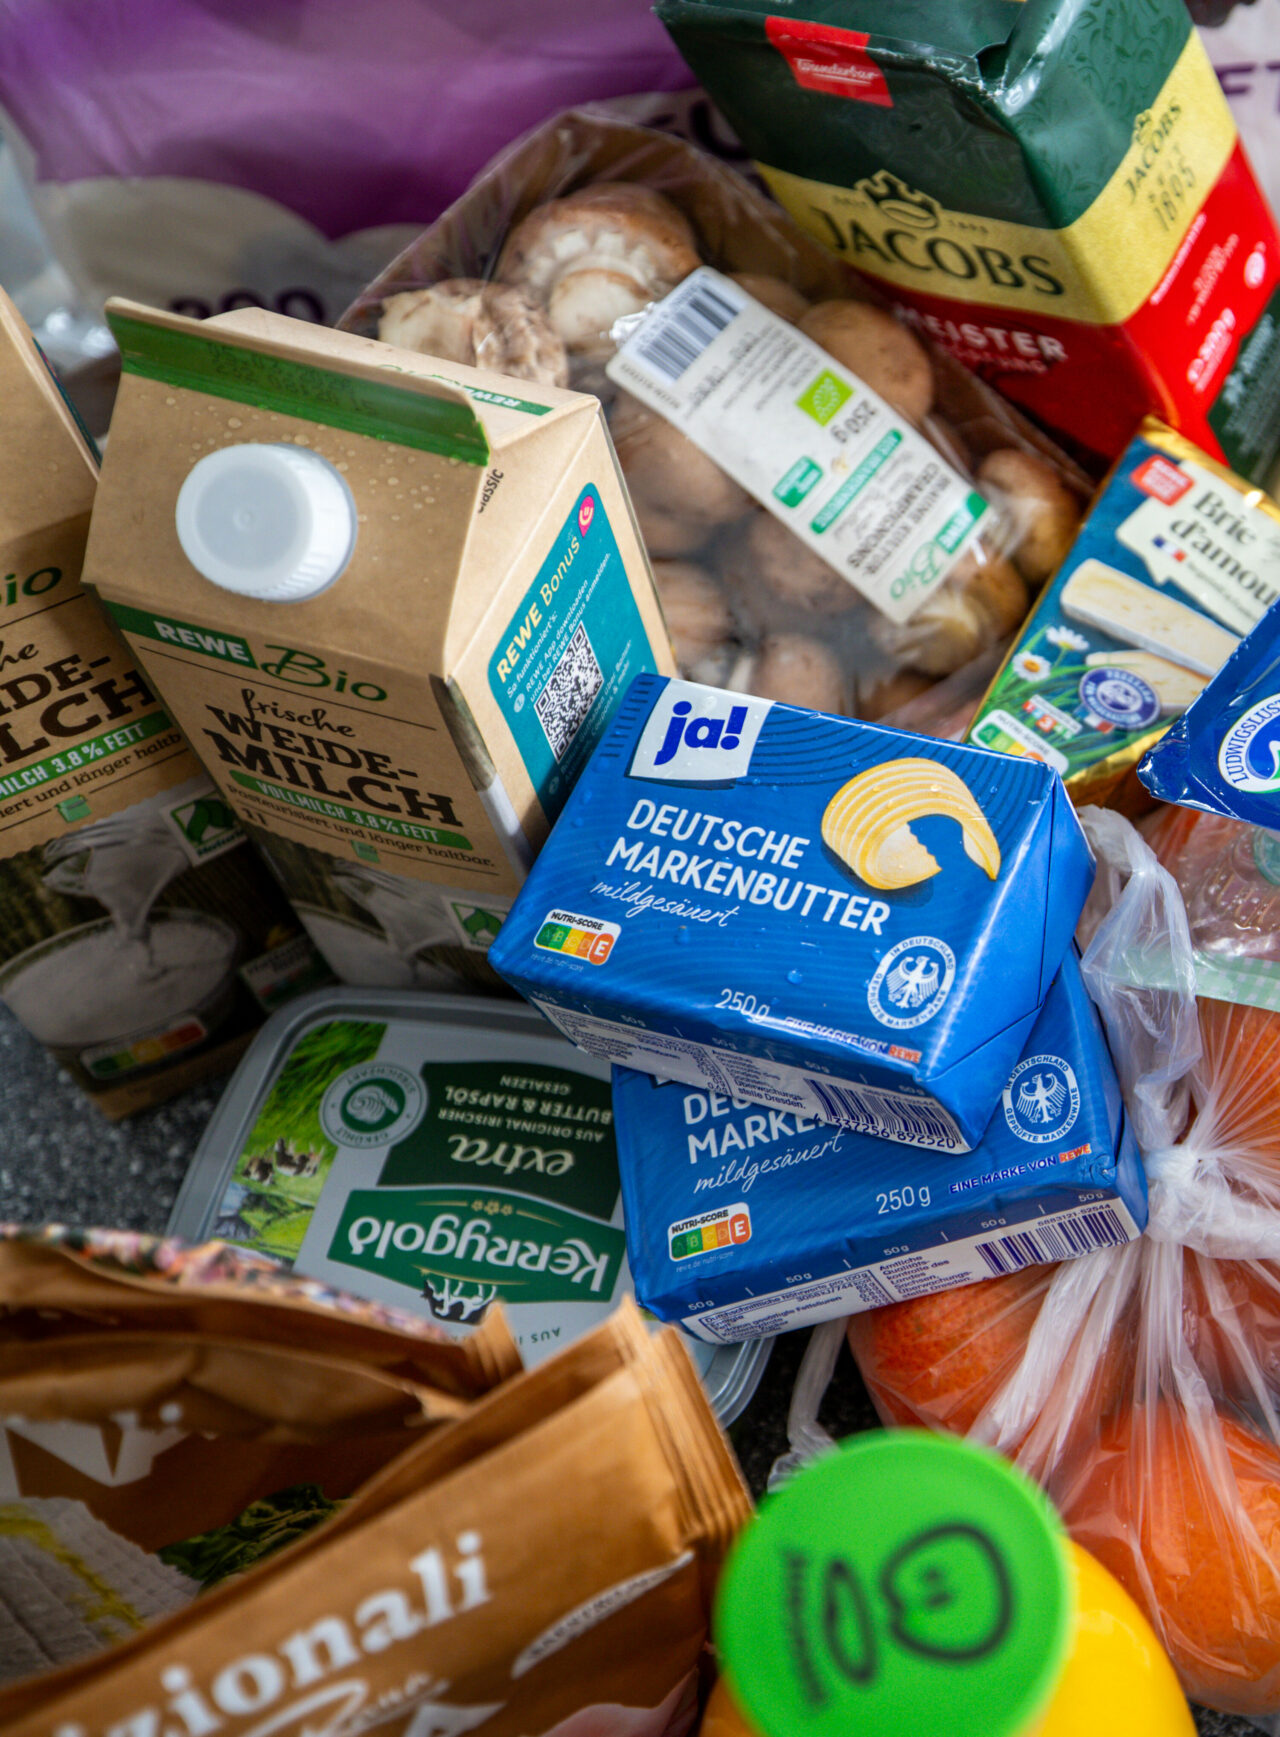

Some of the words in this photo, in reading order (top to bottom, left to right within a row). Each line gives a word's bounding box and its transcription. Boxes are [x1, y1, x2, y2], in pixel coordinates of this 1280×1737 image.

[811, 206, 1064, 296] JACOBS
[1193, 489, 1257, 546] Brie
[2, 566, 63, 607] io
[889, 540, 949, 601] Bio
[1170, 517, 1280, 606] d'amou
[496, 603, 542, 684] REWE
[540, 535, 580, 608] Bonus
[152, 619, 252, 664] REWE
[259, 643, 388, 702] Bio
[525, 666, 544, 693] REWE
[543, 643, 557, 670] App
[555, 579, 589, 646] downloaden
[529, 677, 544, 703] und
[551, 638, 569, 665] REWE
[567, 604, 585, 640] Bonus
[103, 722, 145, 750] FETT
[240, 687, 356, 739] frische
[652, 694, 750, 767] ja!
[205, 704, 418, 779] WEIDE-
[34, 780, 72, 805] und
[72, 752, 133, 787] länger
[202, 727, 465, 828] MILCH
[226, 783, 332, 830] Pasteurisiert
[334, 822, 366, 842] und
[367, 828, 426, 857] länger
[427, 843, 496, 868] haltbar.
[256, 781, 348, 822] VOLLMILCH
[401, 824, 440, 844] FETT
[626, 798, 812, 872] DEUTSCHE
[588, 877, 744, 929] mildgesäuert
[605, 836, 892, 936] MARKENBUTTER
[550, 911, 605, 931] NUTRI-SCORE
[901, 936, 956, 970] DEUTSCHLAND
[714, 988, 757, 1017] 250
[885, 987, 948, 1030] MARKENWARE
[888, 1043, 923, 1065] REWE
[1010, 1055, 1070, 1082] DEUTSCHLAND
[443, 1086, 520, 1110] RAPSÖL
[499, 1074, 571, 1095] GESALZEN
[522, 1099, 536, 1114] &
[437, 1107, 502, 1126] IRISCHER
[504, 1118, 572, 1138] ORIGINAL
[540, 1100, 612, 1125] BUTTER
[575, 1130, 604, 1143] AUS
[832, 1113, 893, 1140] 337256
[896, 1127, 957, 1151] 892520
[1005, 1106, 1039, 1143] GEPRÜFTE
[1040, 1086, 1080, 1143] MARKENWARE
[447, 1134, 575, 1177] extra
[693, 1127, 846, 1196] mildgesäuert
[949, 1177, 979, 1195] EINE
[980, 1164, 1025, 1187] MARKE
[1026, 1155, 1057, 1175] VON
[1058, 1143, 1093, 1163] REWE
[671, 1210, 730, 1235] NUTRI-SCORE
[875, 1187, 914, 1215] 250
[918, 1186, 932, 1209] g
[347, 1213, 609, 1292] Kerrygold
[879, 1255, 923, 1271] Amtliche
[529, 1327, 561, 1344] AUS
